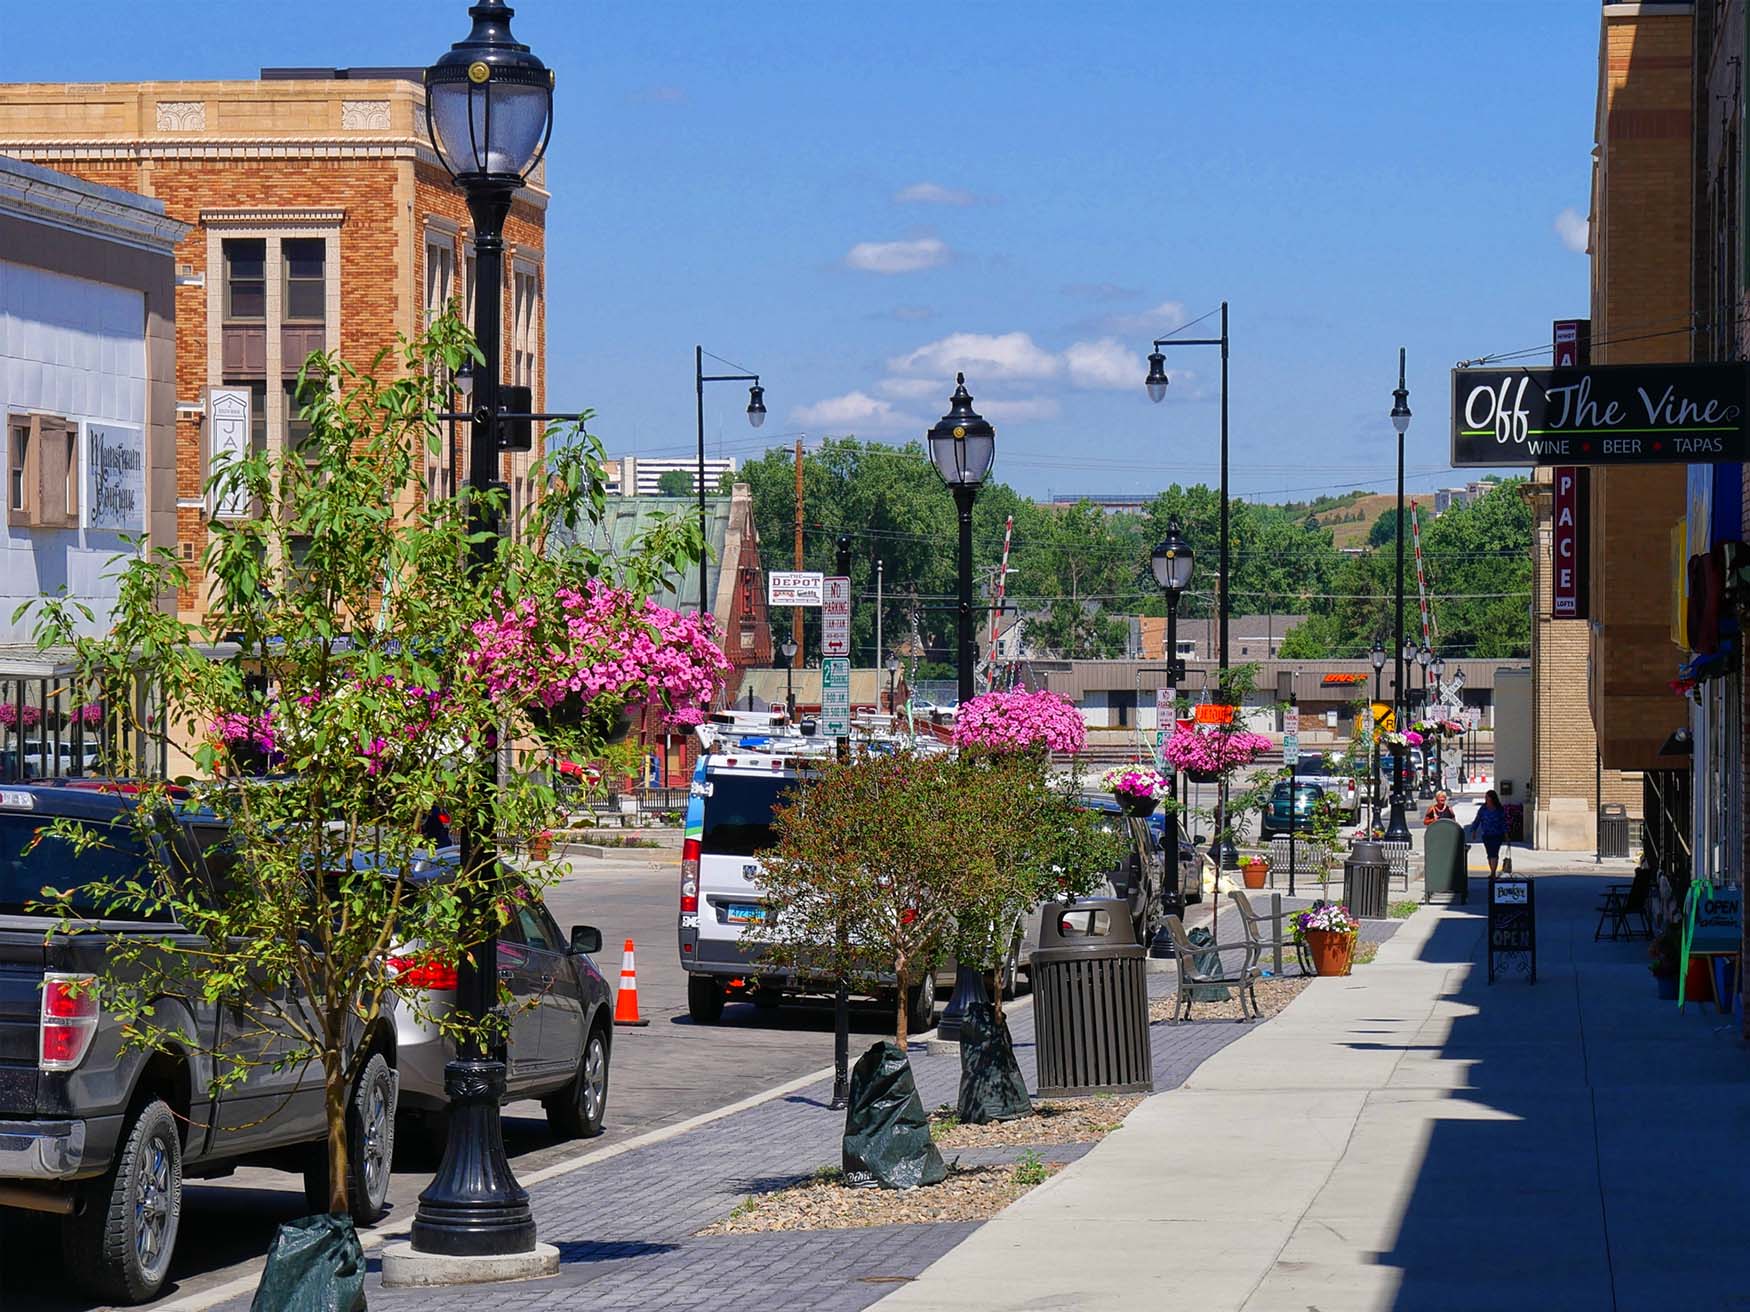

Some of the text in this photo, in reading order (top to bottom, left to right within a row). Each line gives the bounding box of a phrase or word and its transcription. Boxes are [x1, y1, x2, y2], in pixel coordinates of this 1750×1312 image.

[1465, 376, 1732, 444] Off The Vine
[1528, 438, 1723, 456] WINE BEER TAPAS
[772, 578, 821, 587] DEPOT
[831, 584, 841, 599] NO
[824, 601, 848, 615] PARKING
[824, 664, 831, 684] 2
[1387, 720, 1393, 728] R
[1704, 900, 1738, 914] OPEN
[1493, 930, 1529, 946] OPEN
